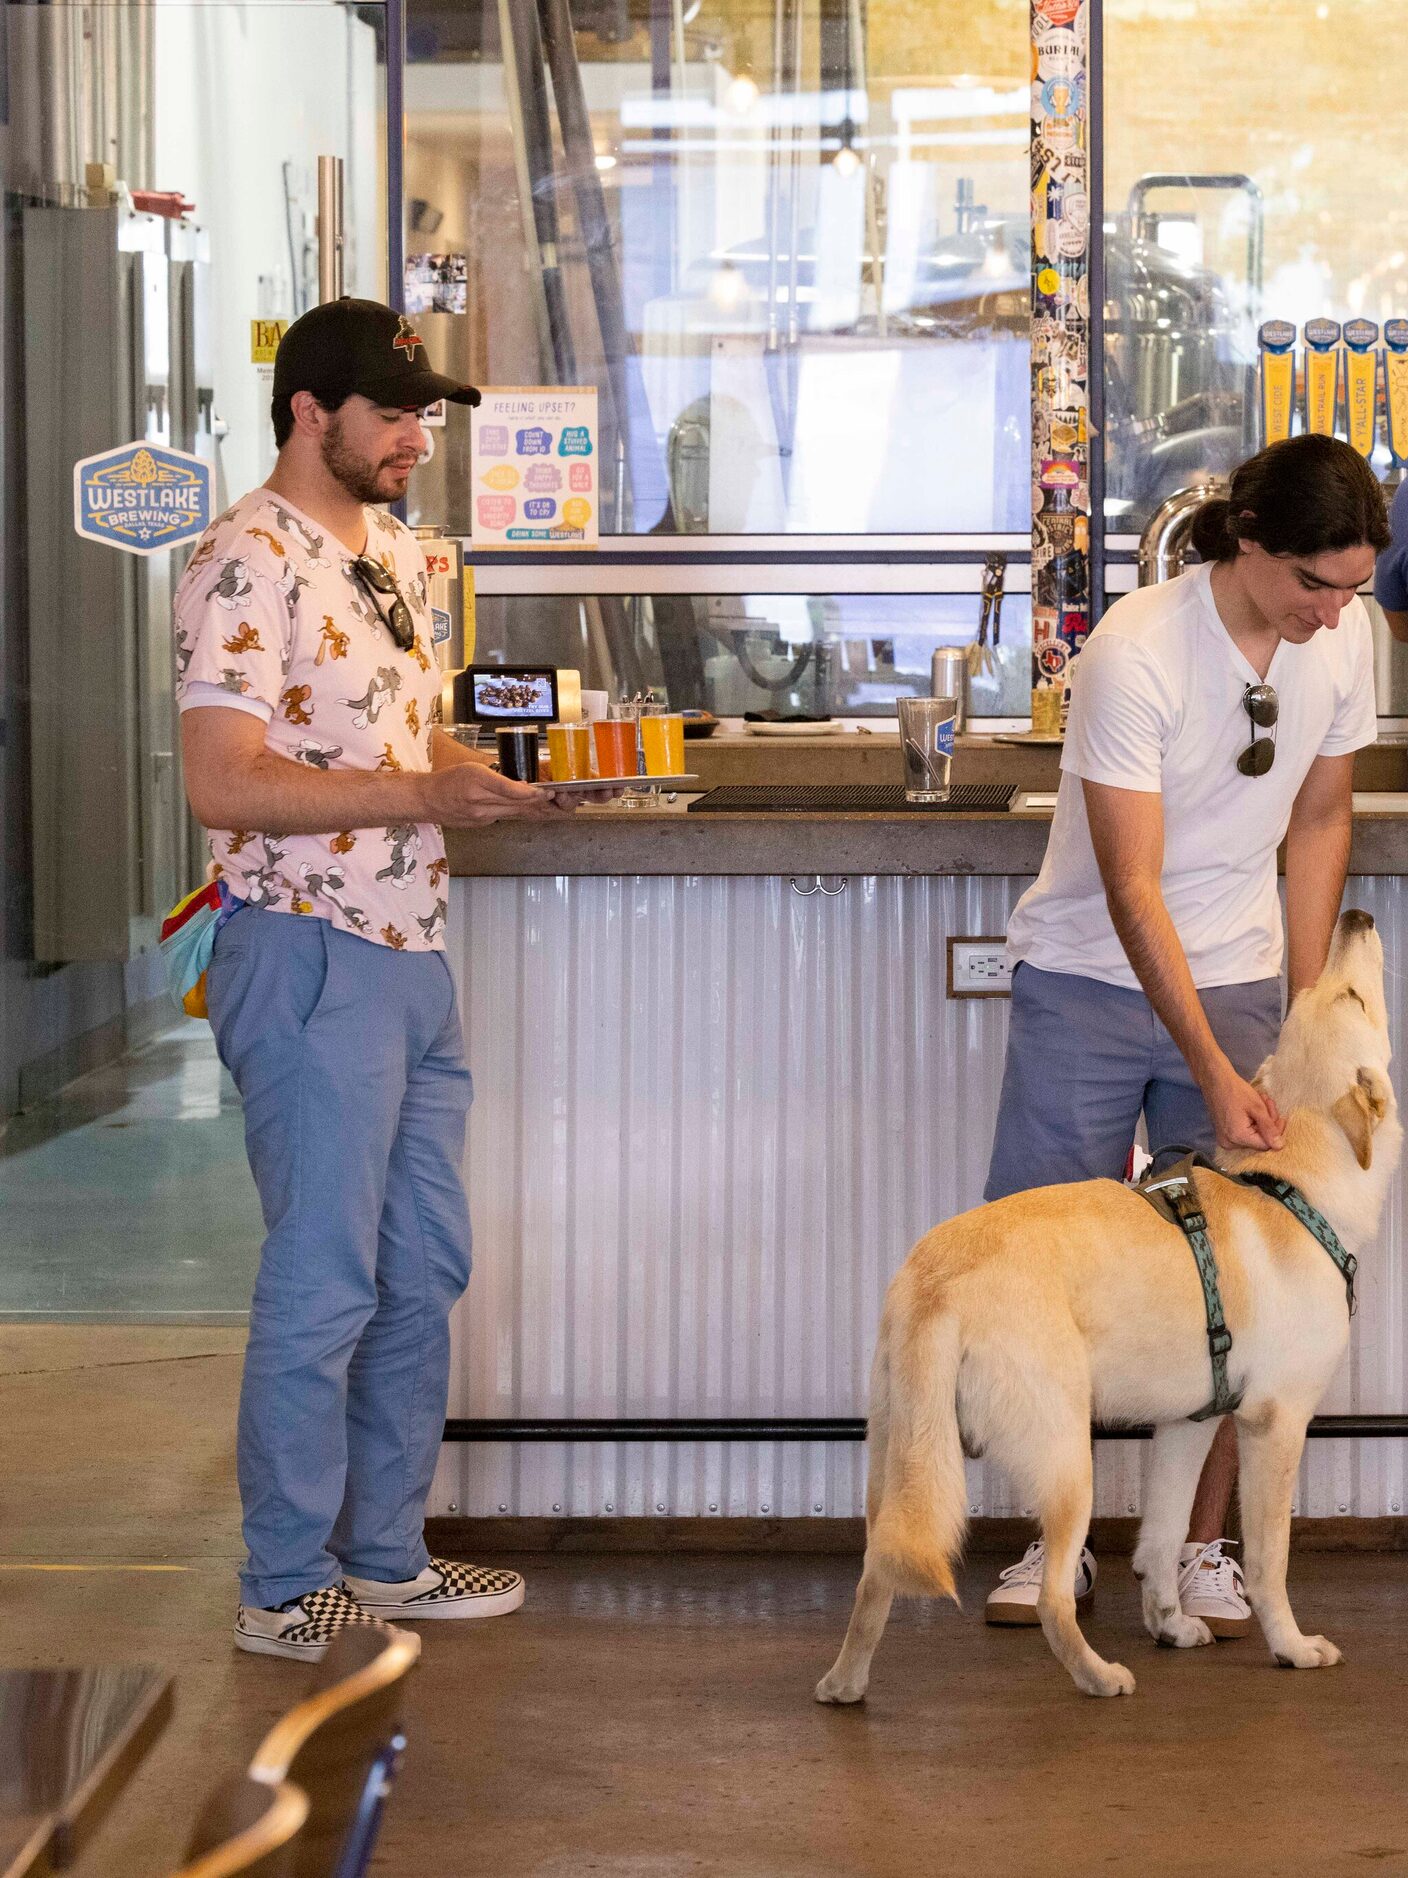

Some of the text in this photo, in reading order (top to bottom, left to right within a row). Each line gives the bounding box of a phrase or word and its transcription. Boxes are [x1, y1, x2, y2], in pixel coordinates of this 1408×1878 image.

[1316, 373, 1326, 390] RUN
[494, 401, 576, 413] FEELING UPSET?
[1272, 384, 1283, 434] WEST CIDE
[1316, 391, 1326, 412] TRAIL
[1355, 378, 1368, 437] Y'ALL-STAR
[87, 486, 201, 511] WESTLAKE
[108, 510, 181, 526] BREWING
[539, 508, 551, 516] CRY
